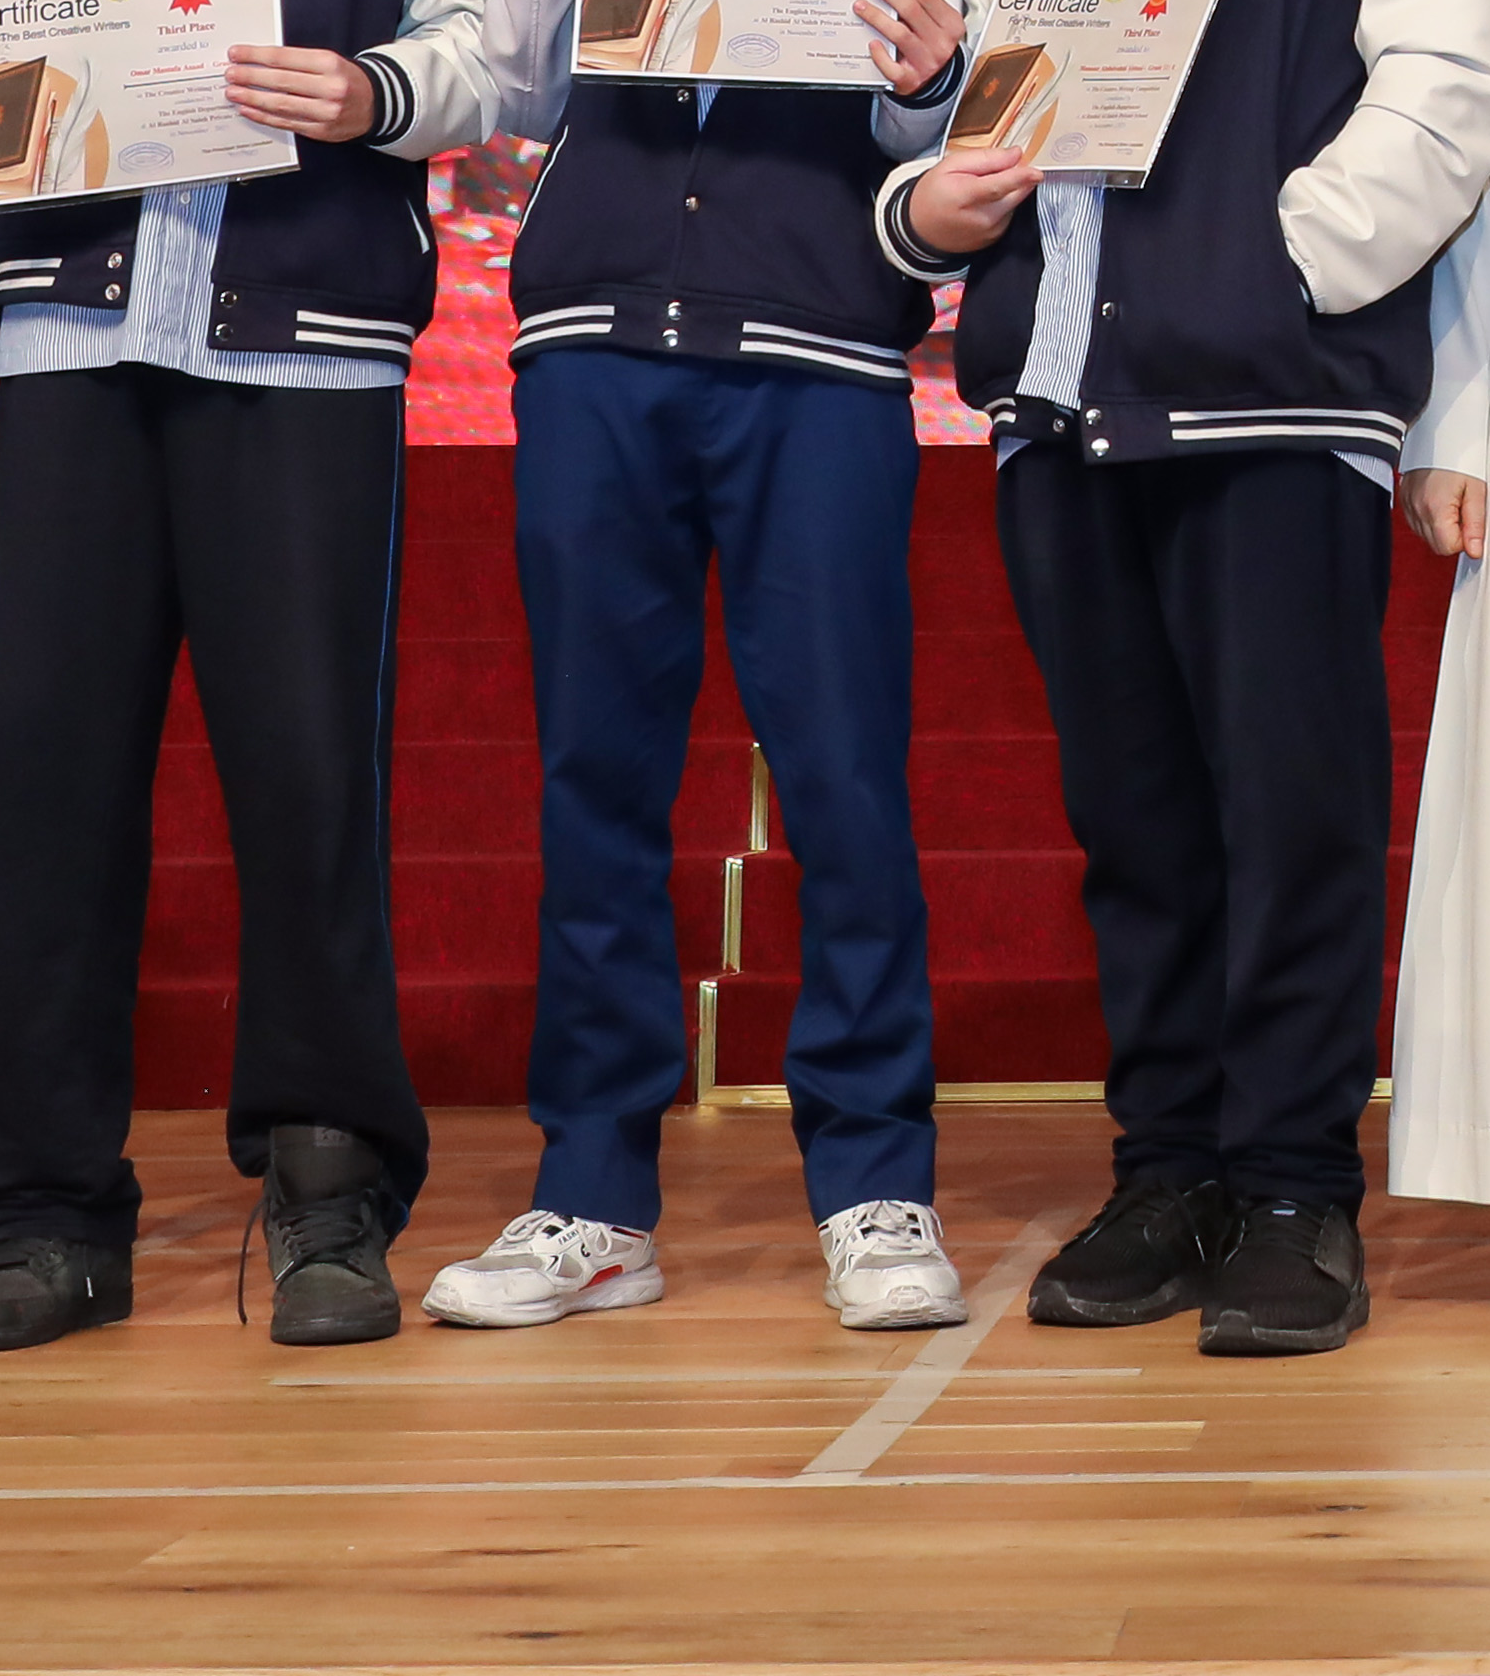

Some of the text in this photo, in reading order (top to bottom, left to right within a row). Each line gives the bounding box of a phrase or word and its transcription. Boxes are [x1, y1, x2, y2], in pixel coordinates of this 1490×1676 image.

[1008, 16, 1111, 28] For The Best Creative Writers
[1, 32, 20, 44] The
[23, 29, 46, 43] Best
[49, 25, 91, 41] Creative
[94, 20, 130, 34] Writers
[158, 22, 215, 36] Third Place
[1124, 29, 1160, 37] Third Place
[158, 42, 197, 53] awarded
